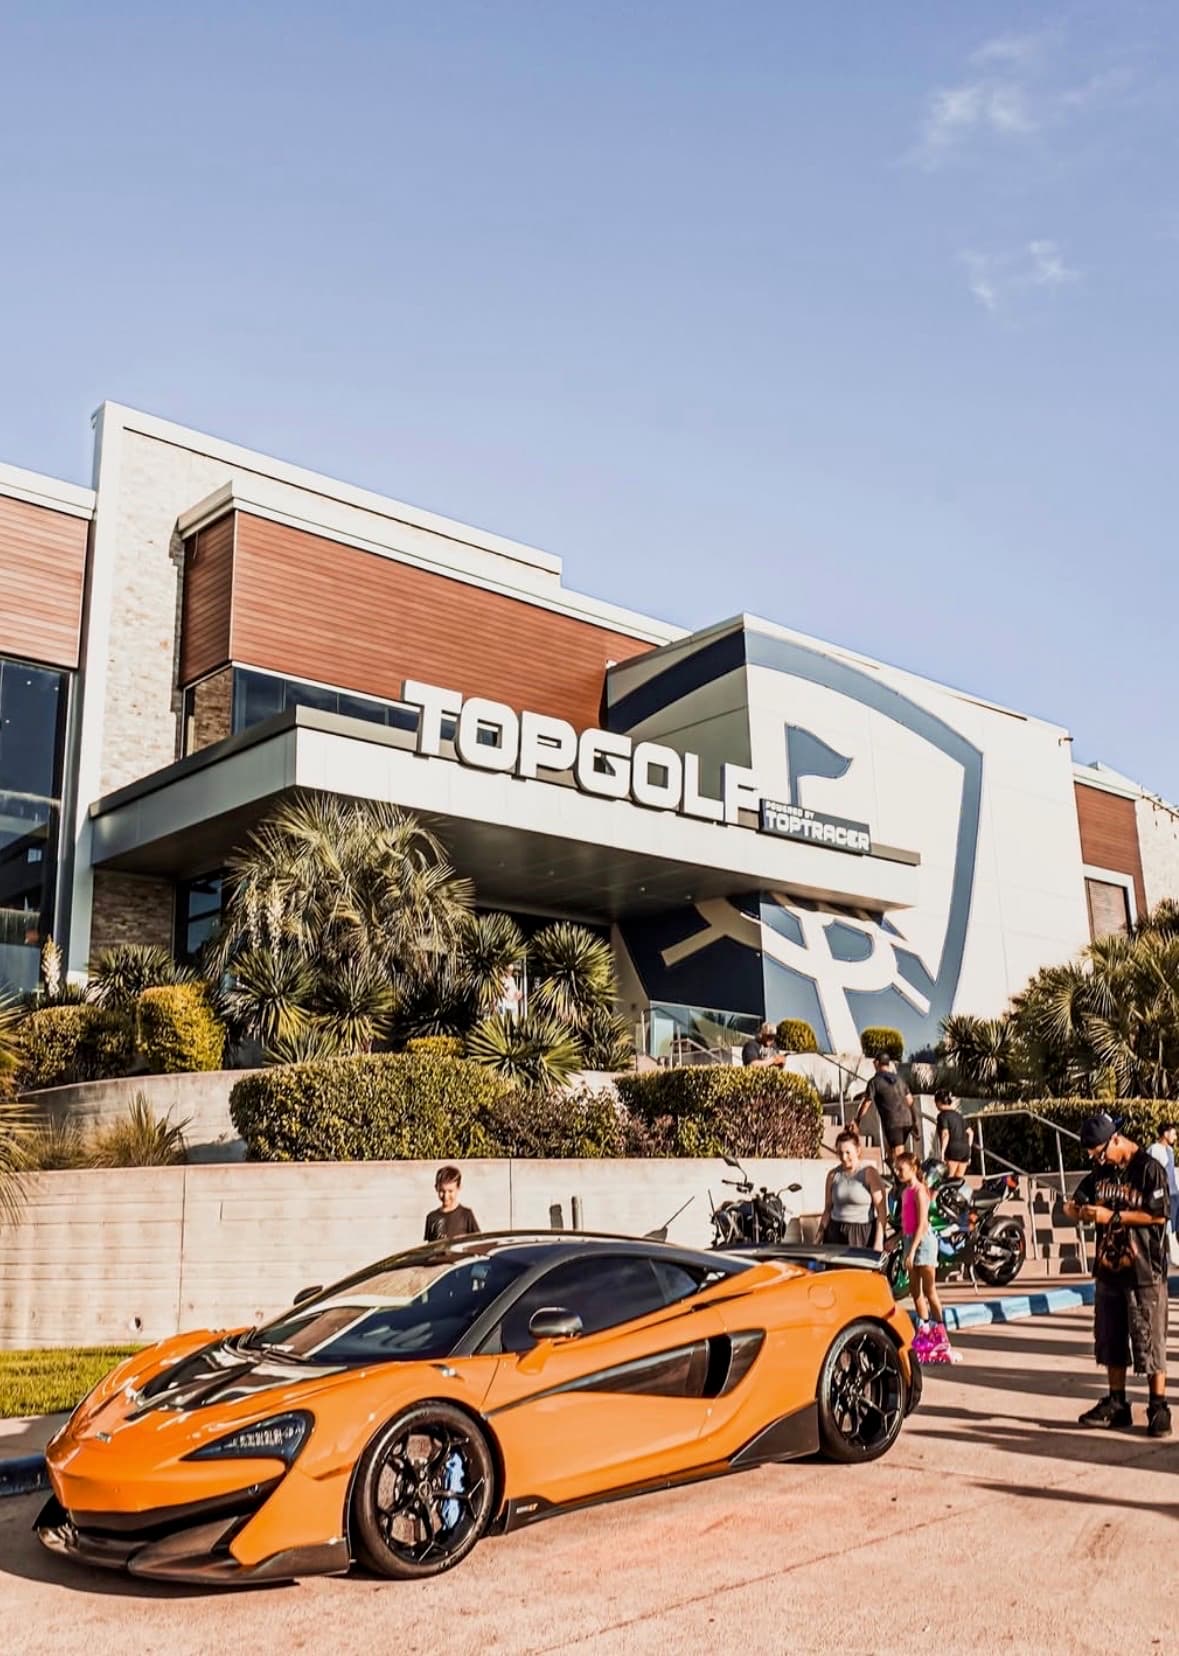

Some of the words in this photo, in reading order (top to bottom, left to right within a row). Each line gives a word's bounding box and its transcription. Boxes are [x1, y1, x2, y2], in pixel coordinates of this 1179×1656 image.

[403, 680, 762, 824] TOPGOLF
[765, 800, 804, 818] POWERED
[804, 811, 816, 821] BY
[765, 810, 870, 850] TOPTRACER
